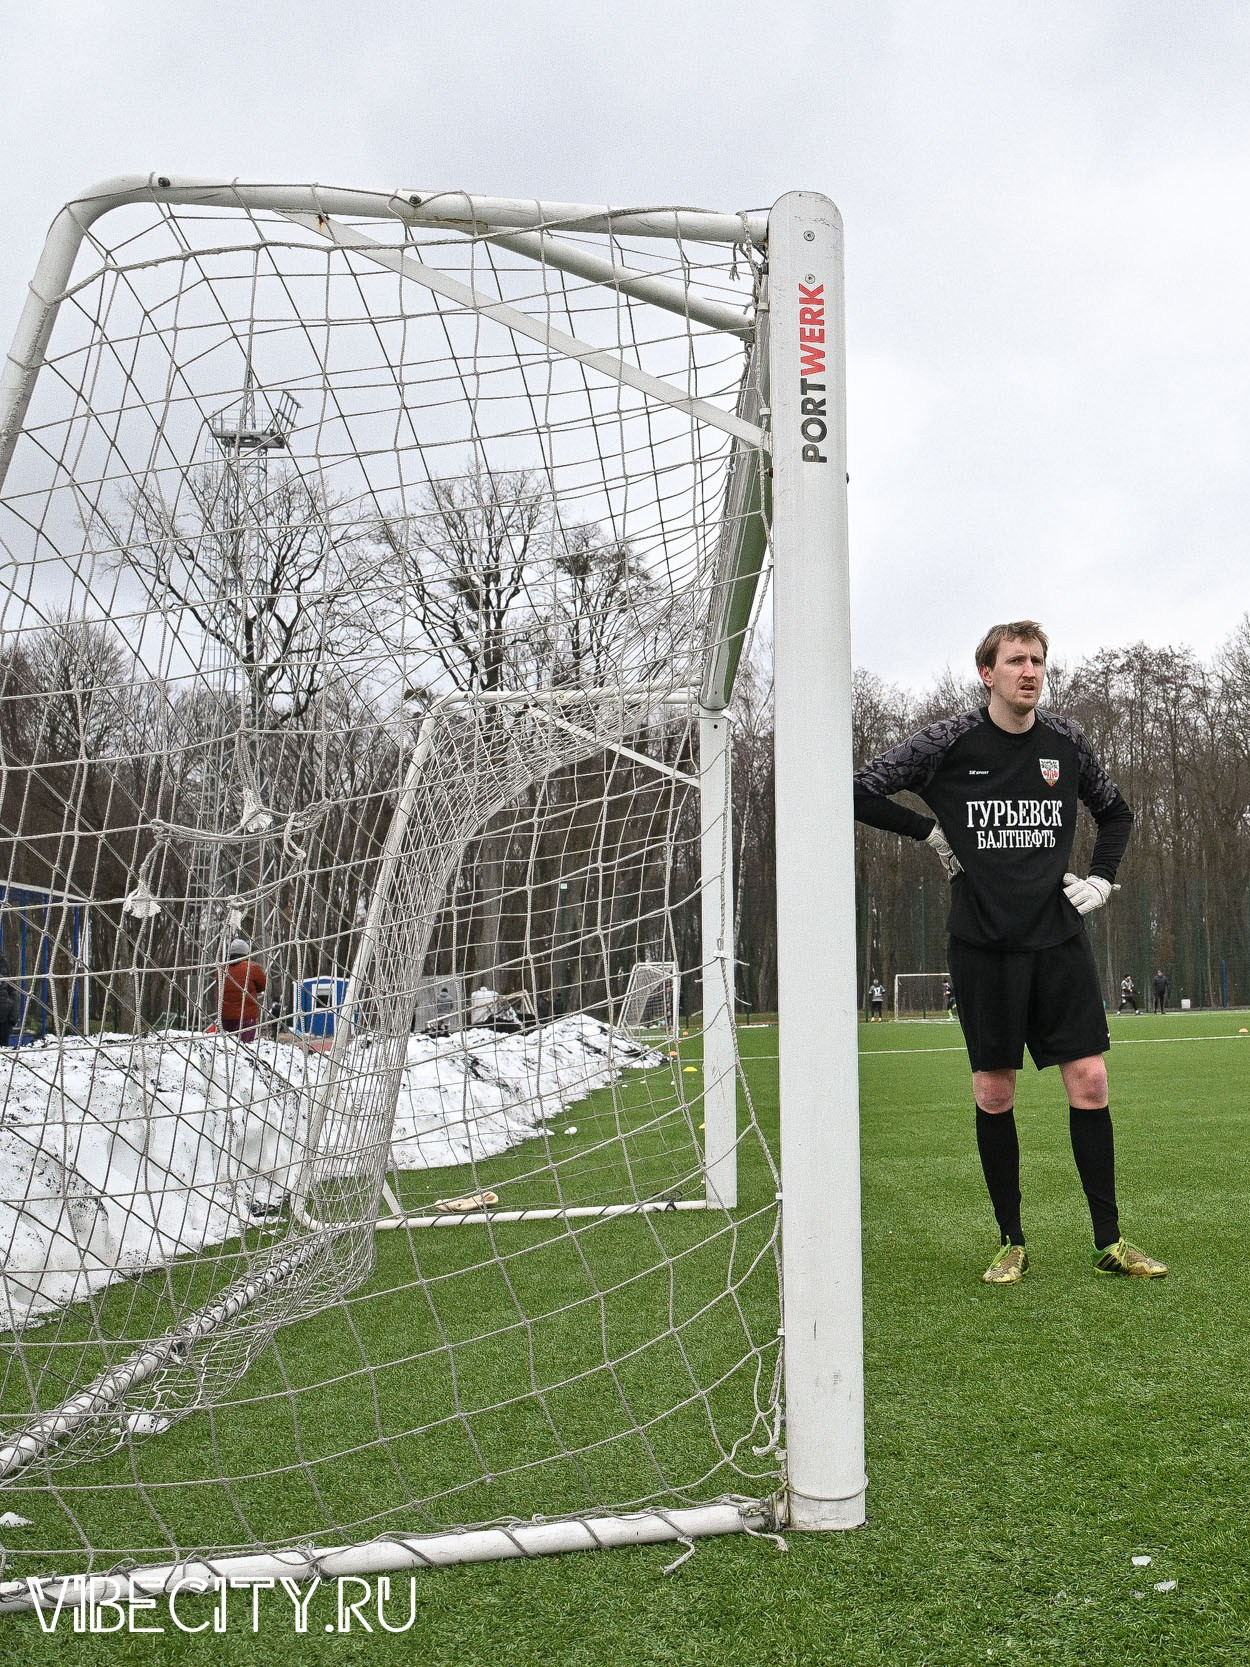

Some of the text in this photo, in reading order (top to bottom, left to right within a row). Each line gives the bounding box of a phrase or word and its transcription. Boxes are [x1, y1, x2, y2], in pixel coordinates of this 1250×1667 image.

[798, 282, 828, 463] PORTWERK
[966, 799, 1063, 828] ГУРЬЕВСК
[976, 829, 1056, 850] БАЛТНЕФТЬ
